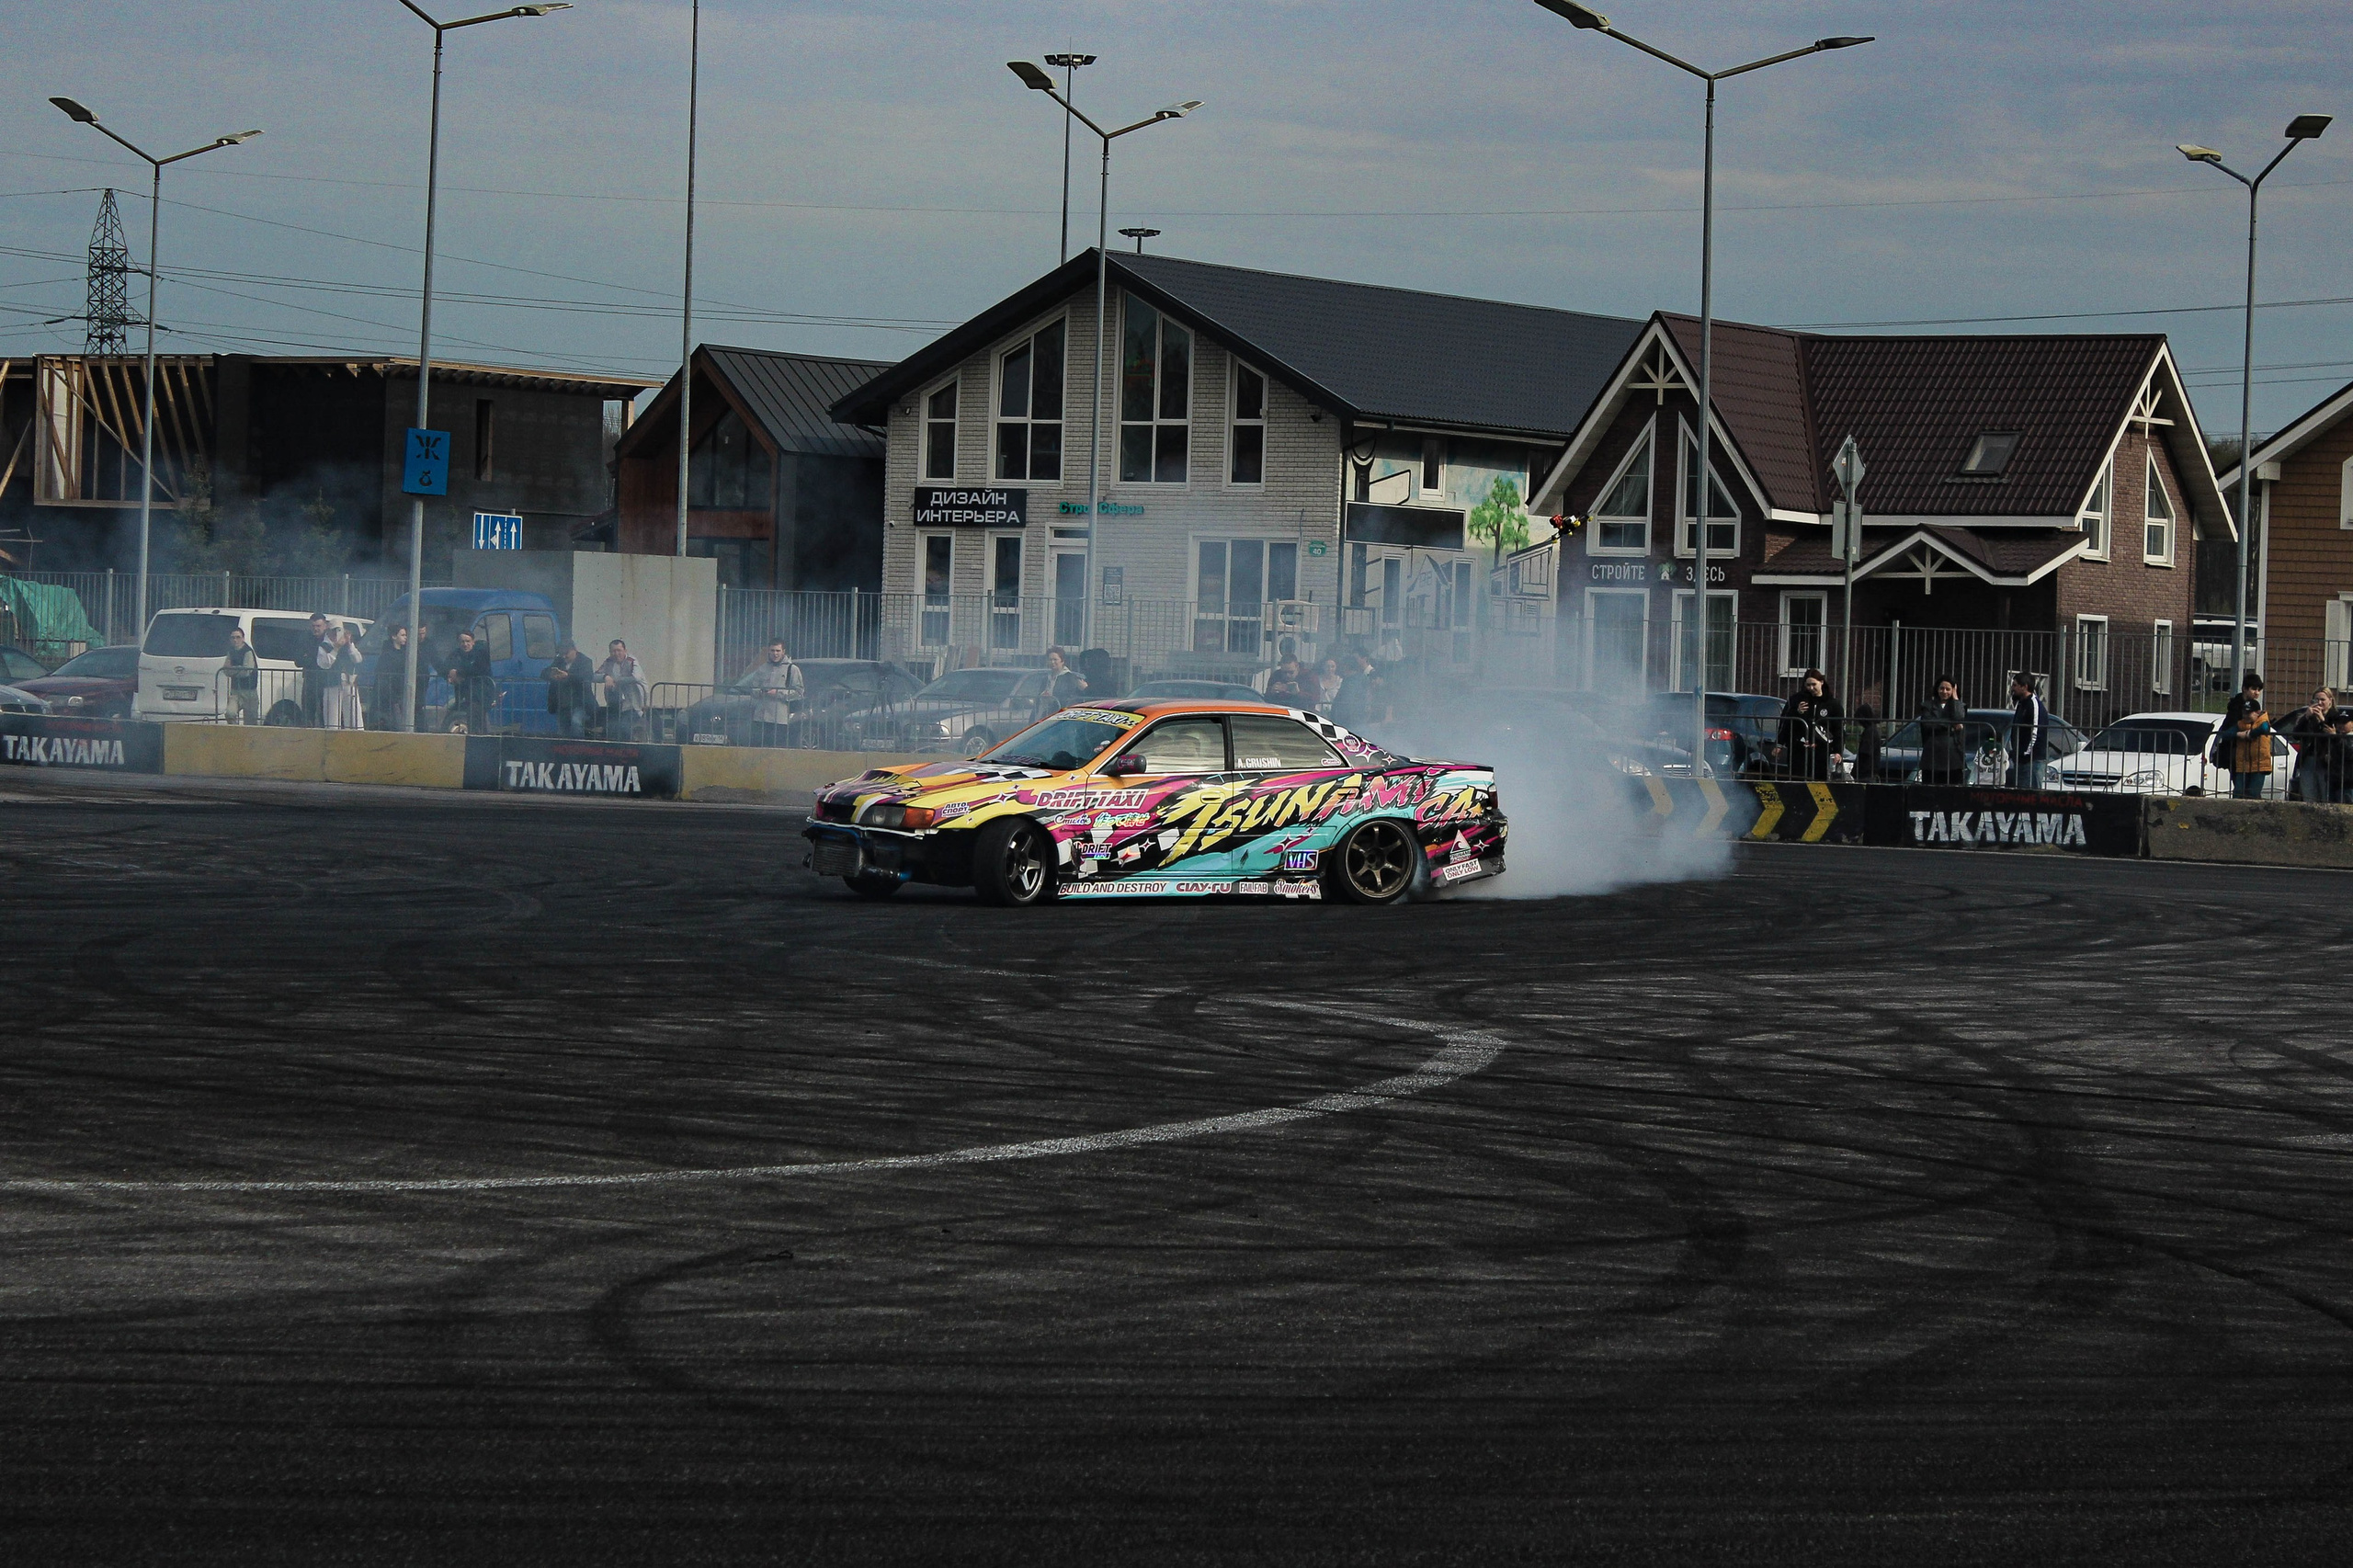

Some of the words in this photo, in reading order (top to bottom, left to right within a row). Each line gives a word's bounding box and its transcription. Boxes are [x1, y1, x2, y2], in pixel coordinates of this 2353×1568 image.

[930, 490, 1007, 506] ДИЗАЙН
[916, 509, 1020, 523] ИНТЕРЬЕРА
[1059, 502, 1144, 517] СтроСфера
[1592, 562, 1645, 580] СТРОЙТЕ
[1686, 566, 1725, 582] ЗЕСЬ
[3, 734, 125, 765] TAKAYAMA
[1237, 757, 1282, 768] A.GRUSHIN
[506, 760, 642, 792] TAKAYAMA
[1037, 791, 1096, 807] DRIFT
[1097, 790, 1145, 807] TAXI
[1909, 811, 2086, 845] TAKAYAMA
[1083, 844, 1111, 853] DRIFT
[1288, 852, 1316, 869] VHS
[1445, 865, 1461, 874] ONLY
[1461, 860, 1477, 869] FAST
[1447, 869, 1464, 879] ONLY
[1464, 866, 1479, 874] LOW
[1060, 883, 1090, 893] BUILD
[1092, 883, 1114, 893] AND
[1117, 882, 1167, 893] DESTROY
[1275, 879, 1319, 894] Smokers
